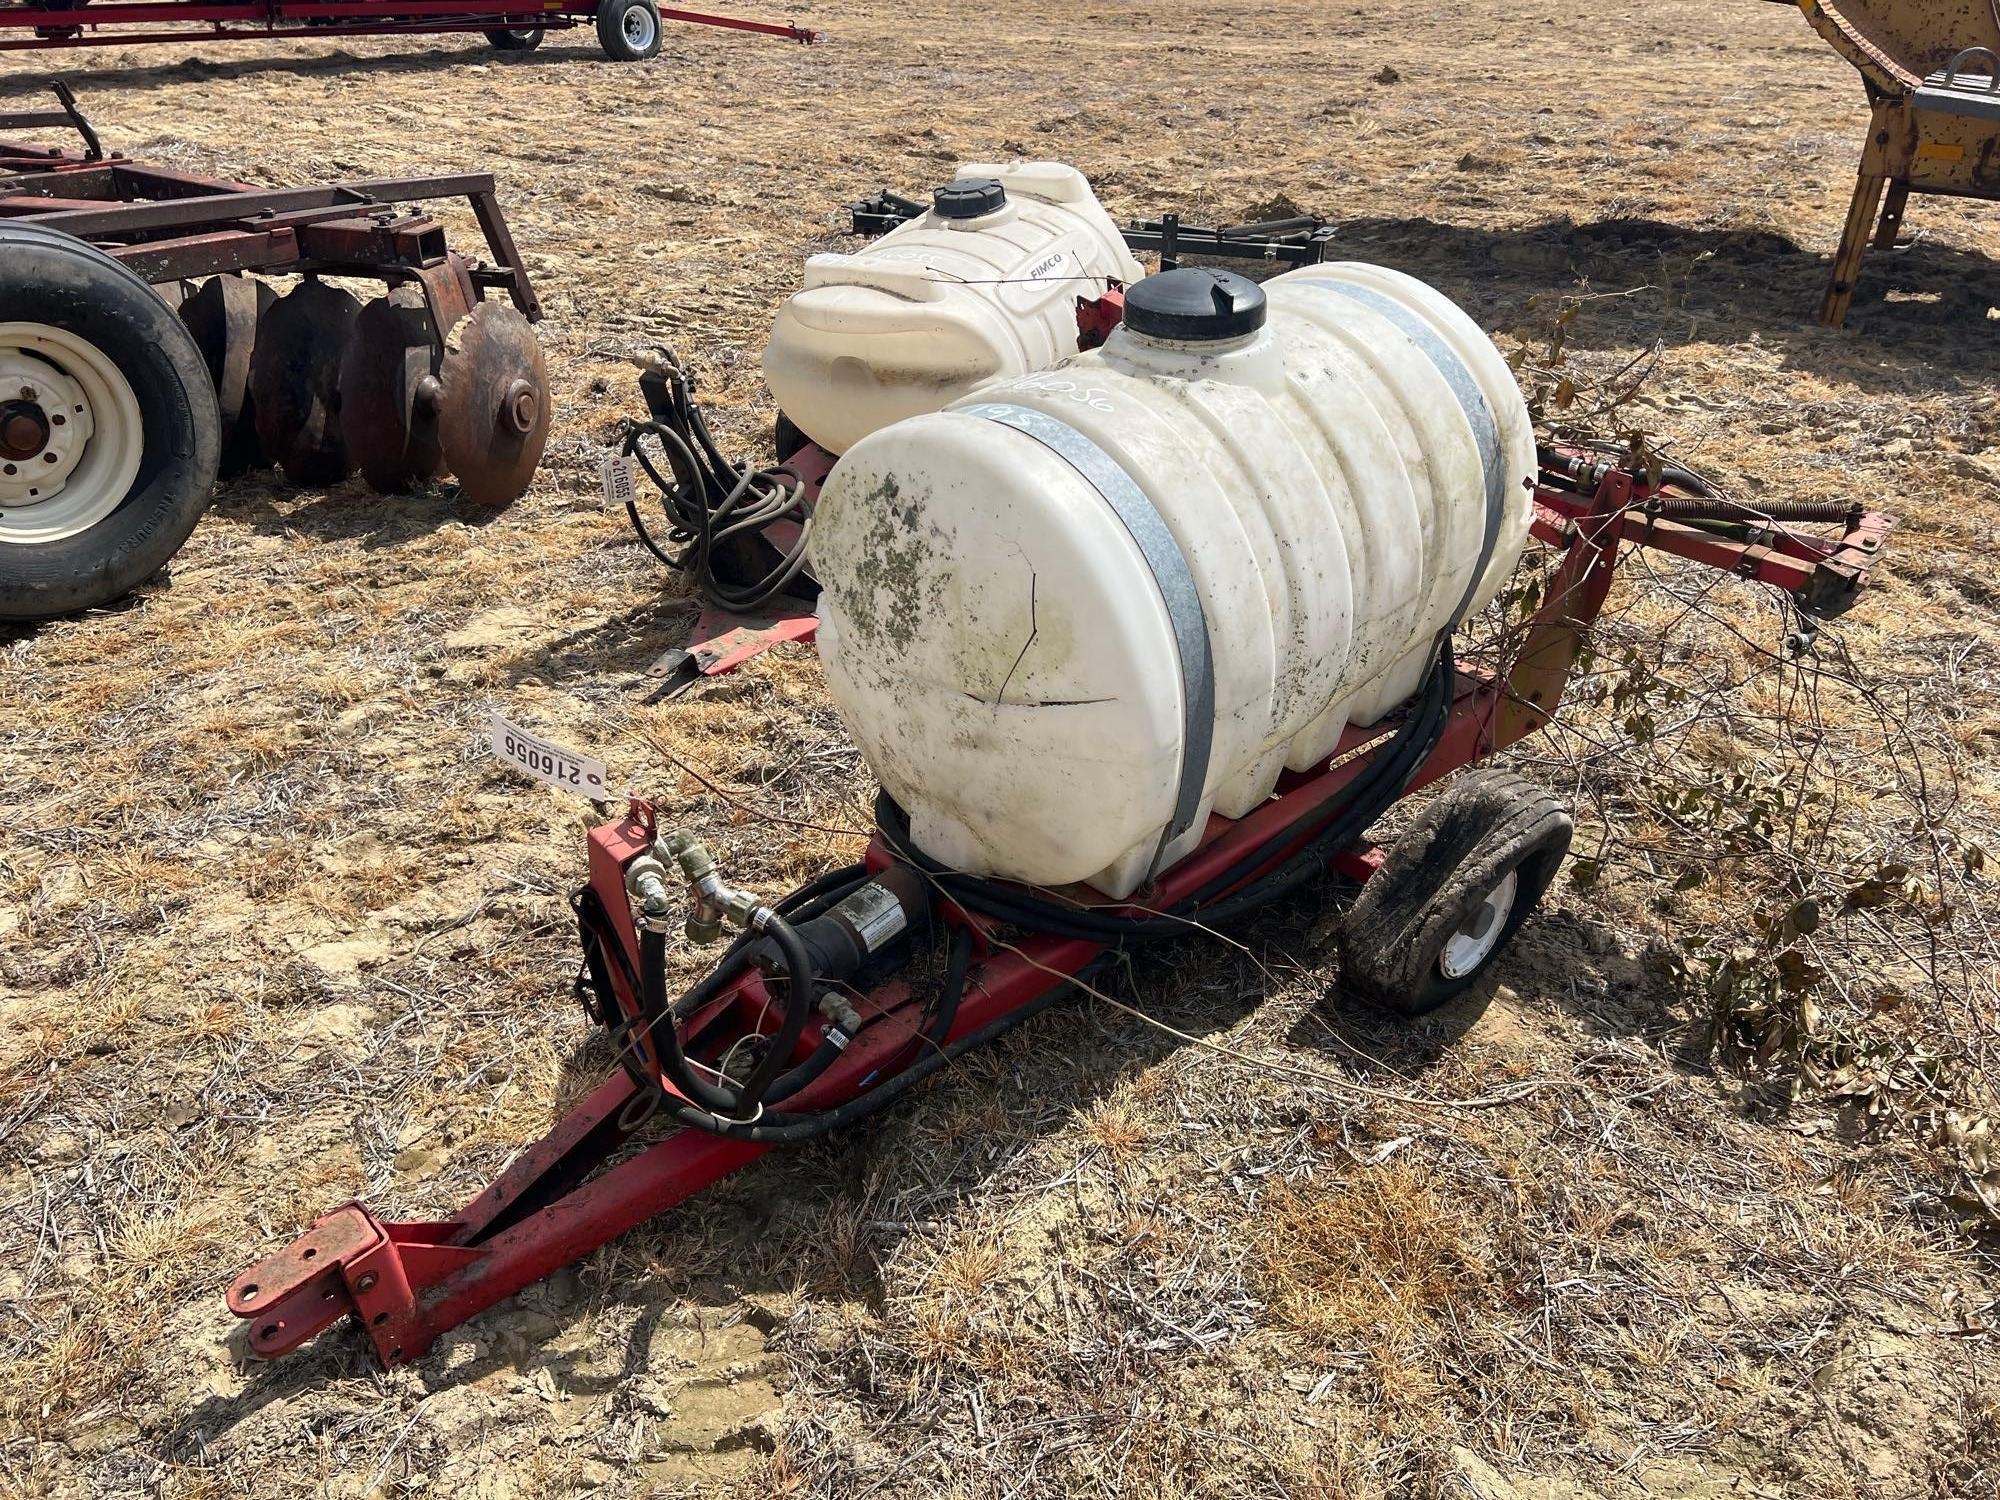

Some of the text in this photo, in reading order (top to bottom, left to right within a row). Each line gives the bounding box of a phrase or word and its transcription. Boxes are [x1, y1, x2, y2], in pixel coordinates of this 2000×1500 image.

[1030, 253, 1062, 280] FIMCO
[613, 465, 630, 499] 216055
[505, 735, 581, 785] 216056
